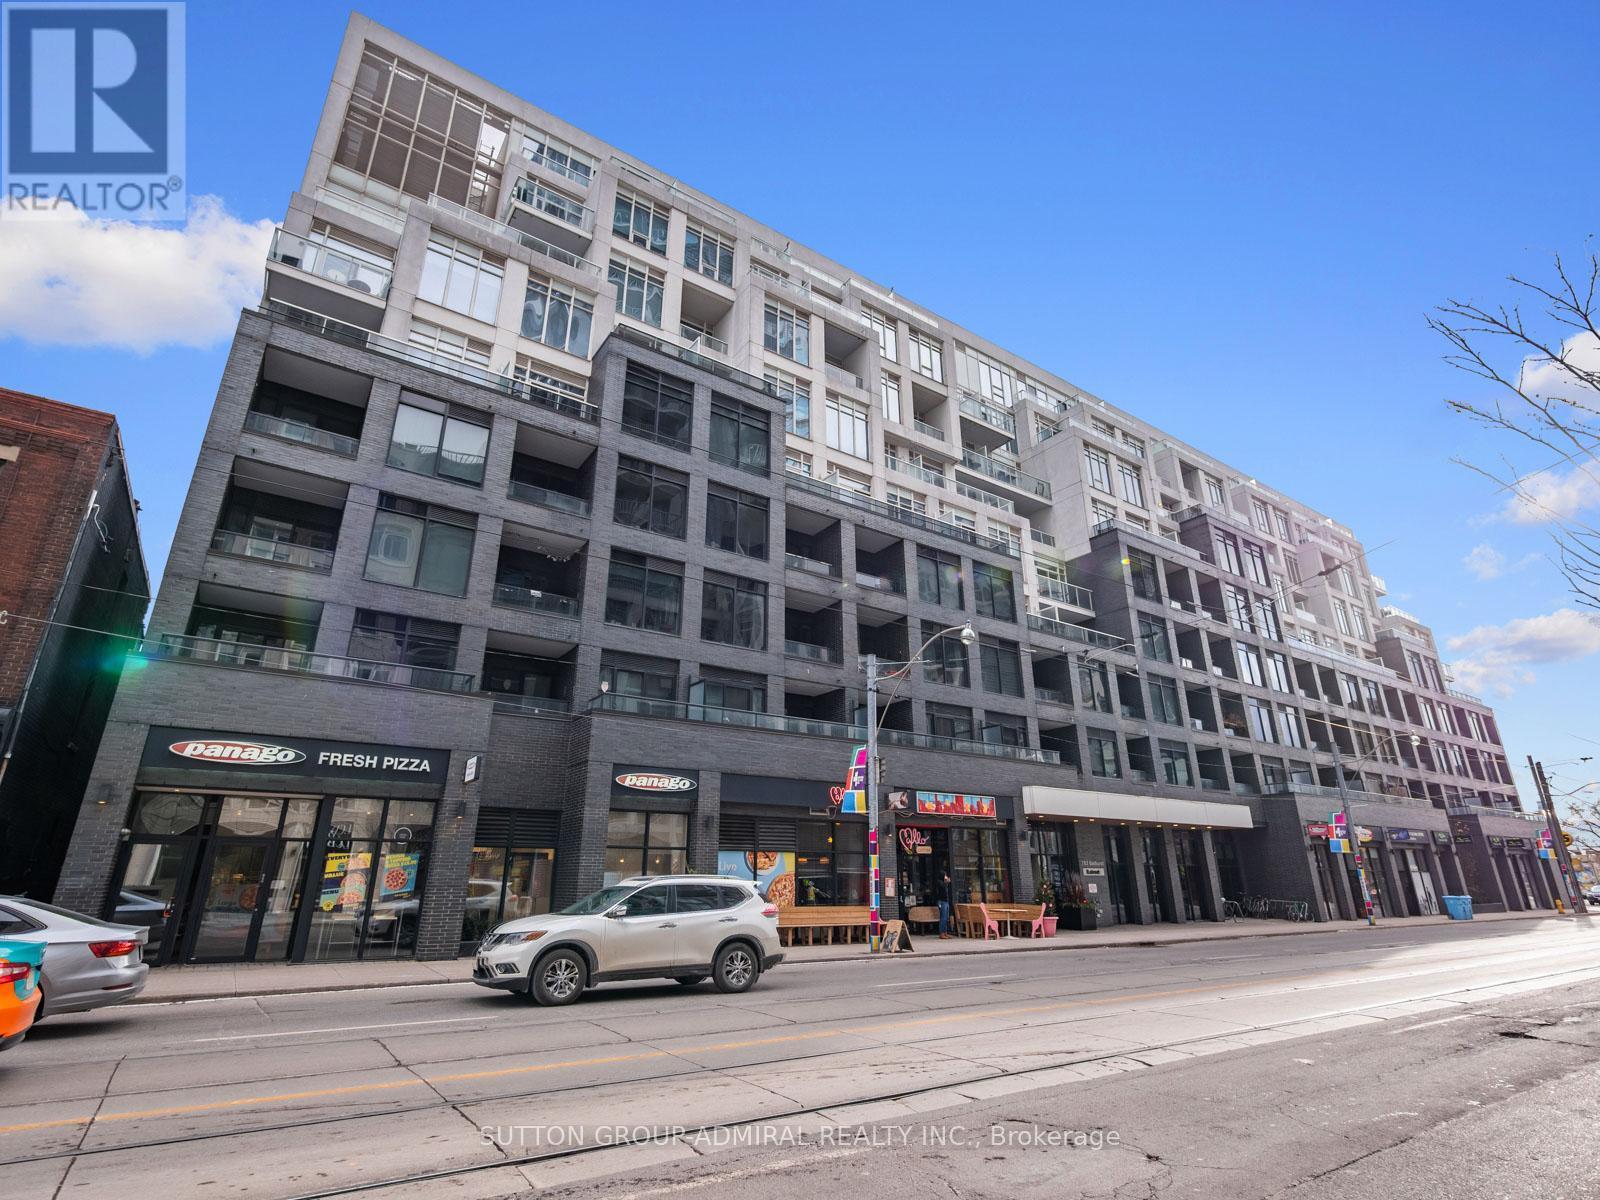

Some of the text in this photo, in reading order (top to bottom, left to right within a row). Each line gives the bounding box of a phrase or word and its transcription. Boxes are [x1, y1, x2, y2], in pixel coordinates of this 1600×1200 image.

[183, 741, 431, 773] panago FRESH PIZZA
[624, 775, 691, 790] panago
